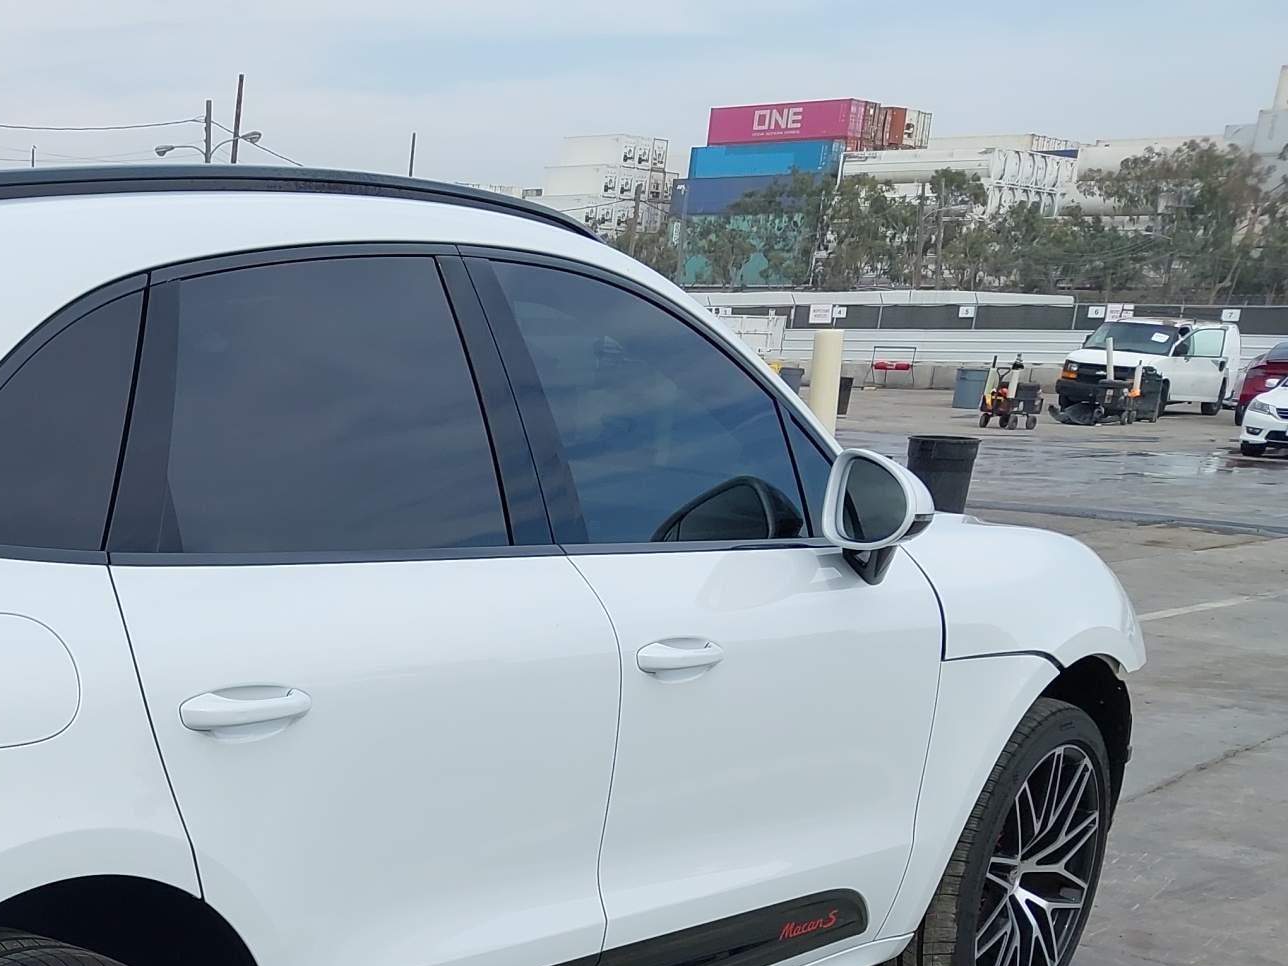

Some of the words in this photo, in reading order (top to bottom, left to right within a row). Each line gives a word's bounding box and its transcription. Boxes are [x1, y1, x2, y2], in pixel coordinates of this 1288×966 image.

[752, 107, 803, 130] ONE
[778, 919, 823, 941] Macan
[823, 909, 839, 928] S
